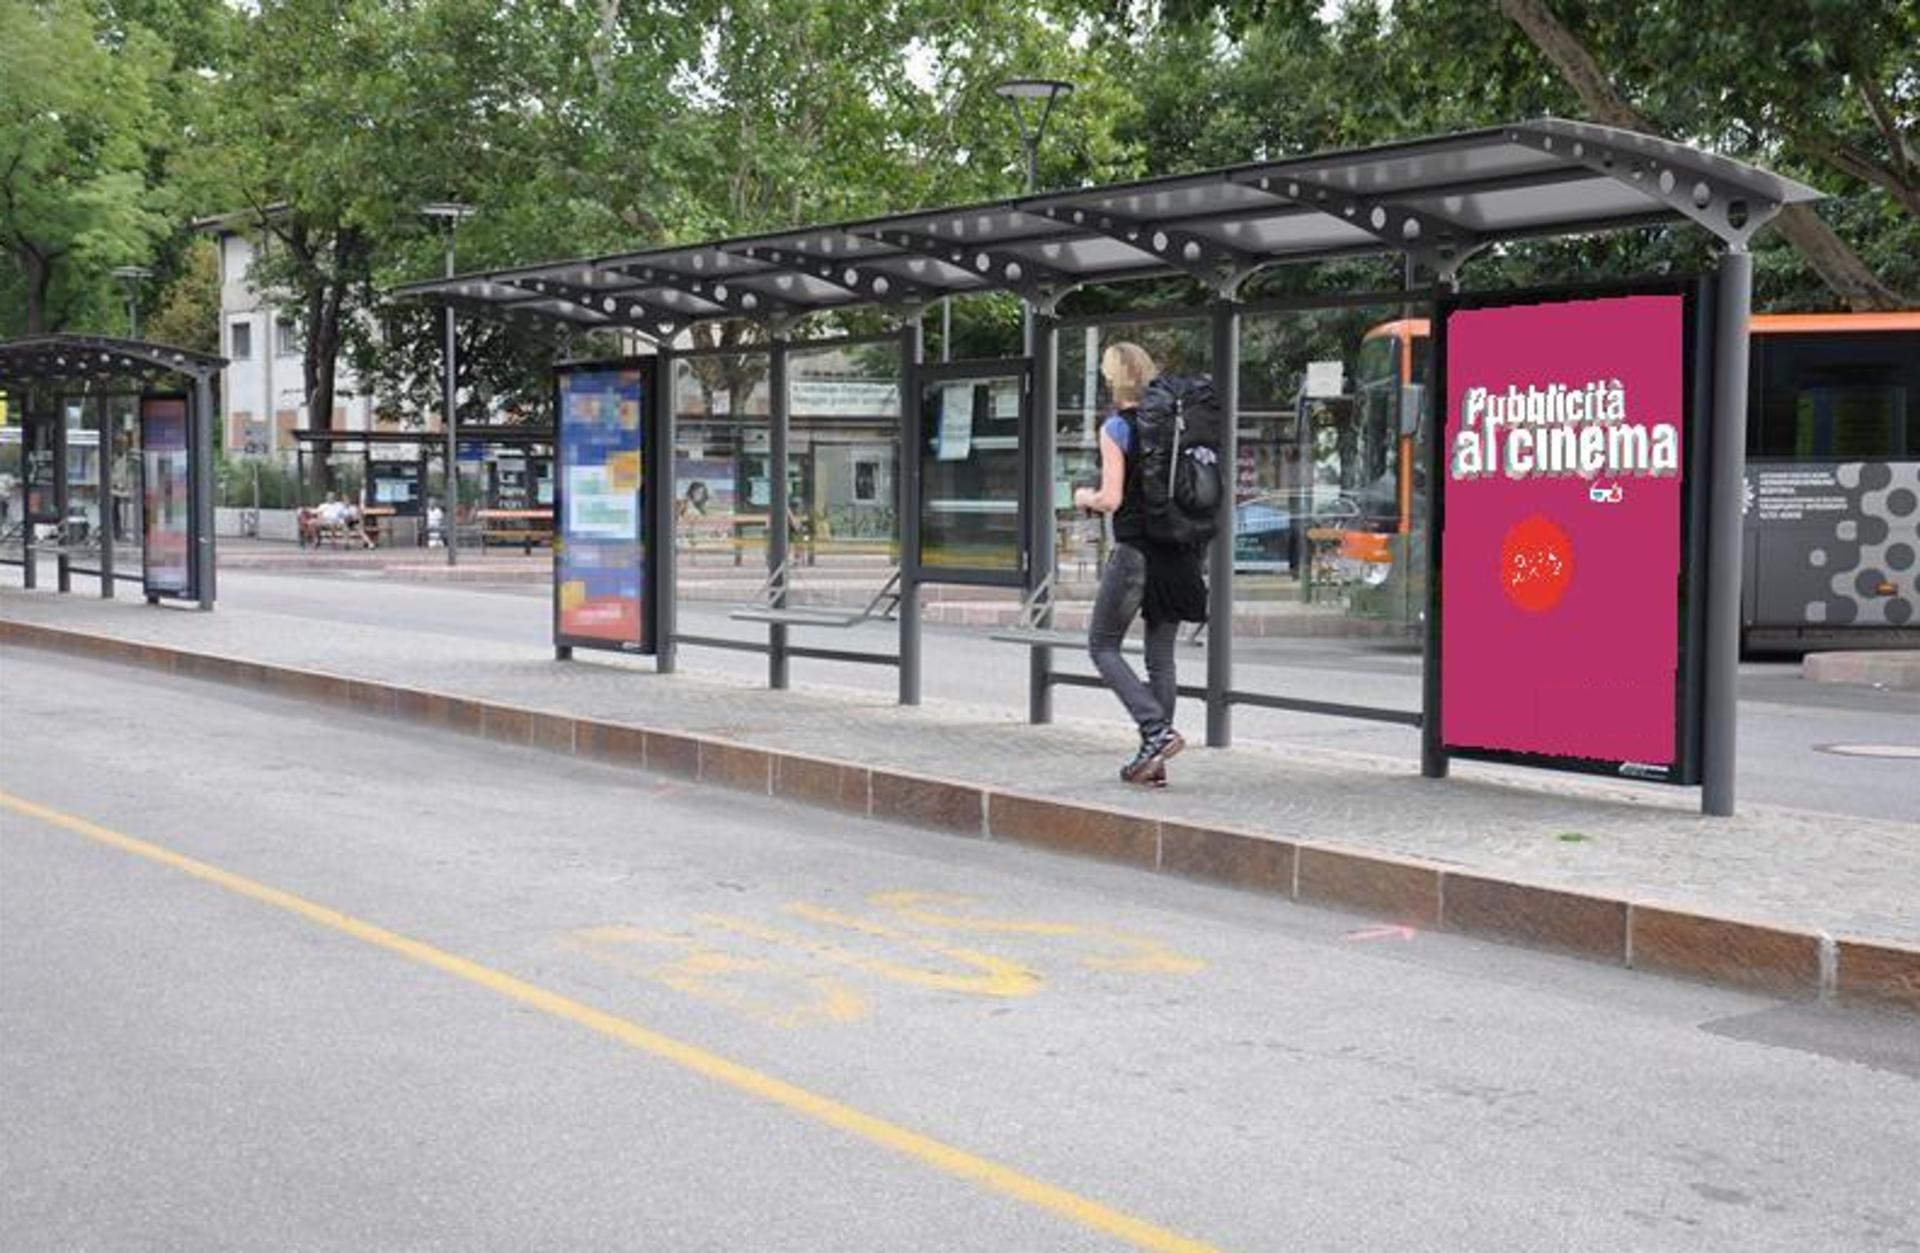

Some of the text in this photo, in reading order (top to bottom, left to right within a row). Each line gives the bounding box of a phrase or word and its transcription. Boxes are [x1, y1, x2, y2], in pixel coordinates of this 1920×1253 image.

[1464, 379, 1626, 426] Pubblicità
[1454, 417, 1679, 477] al cinema
